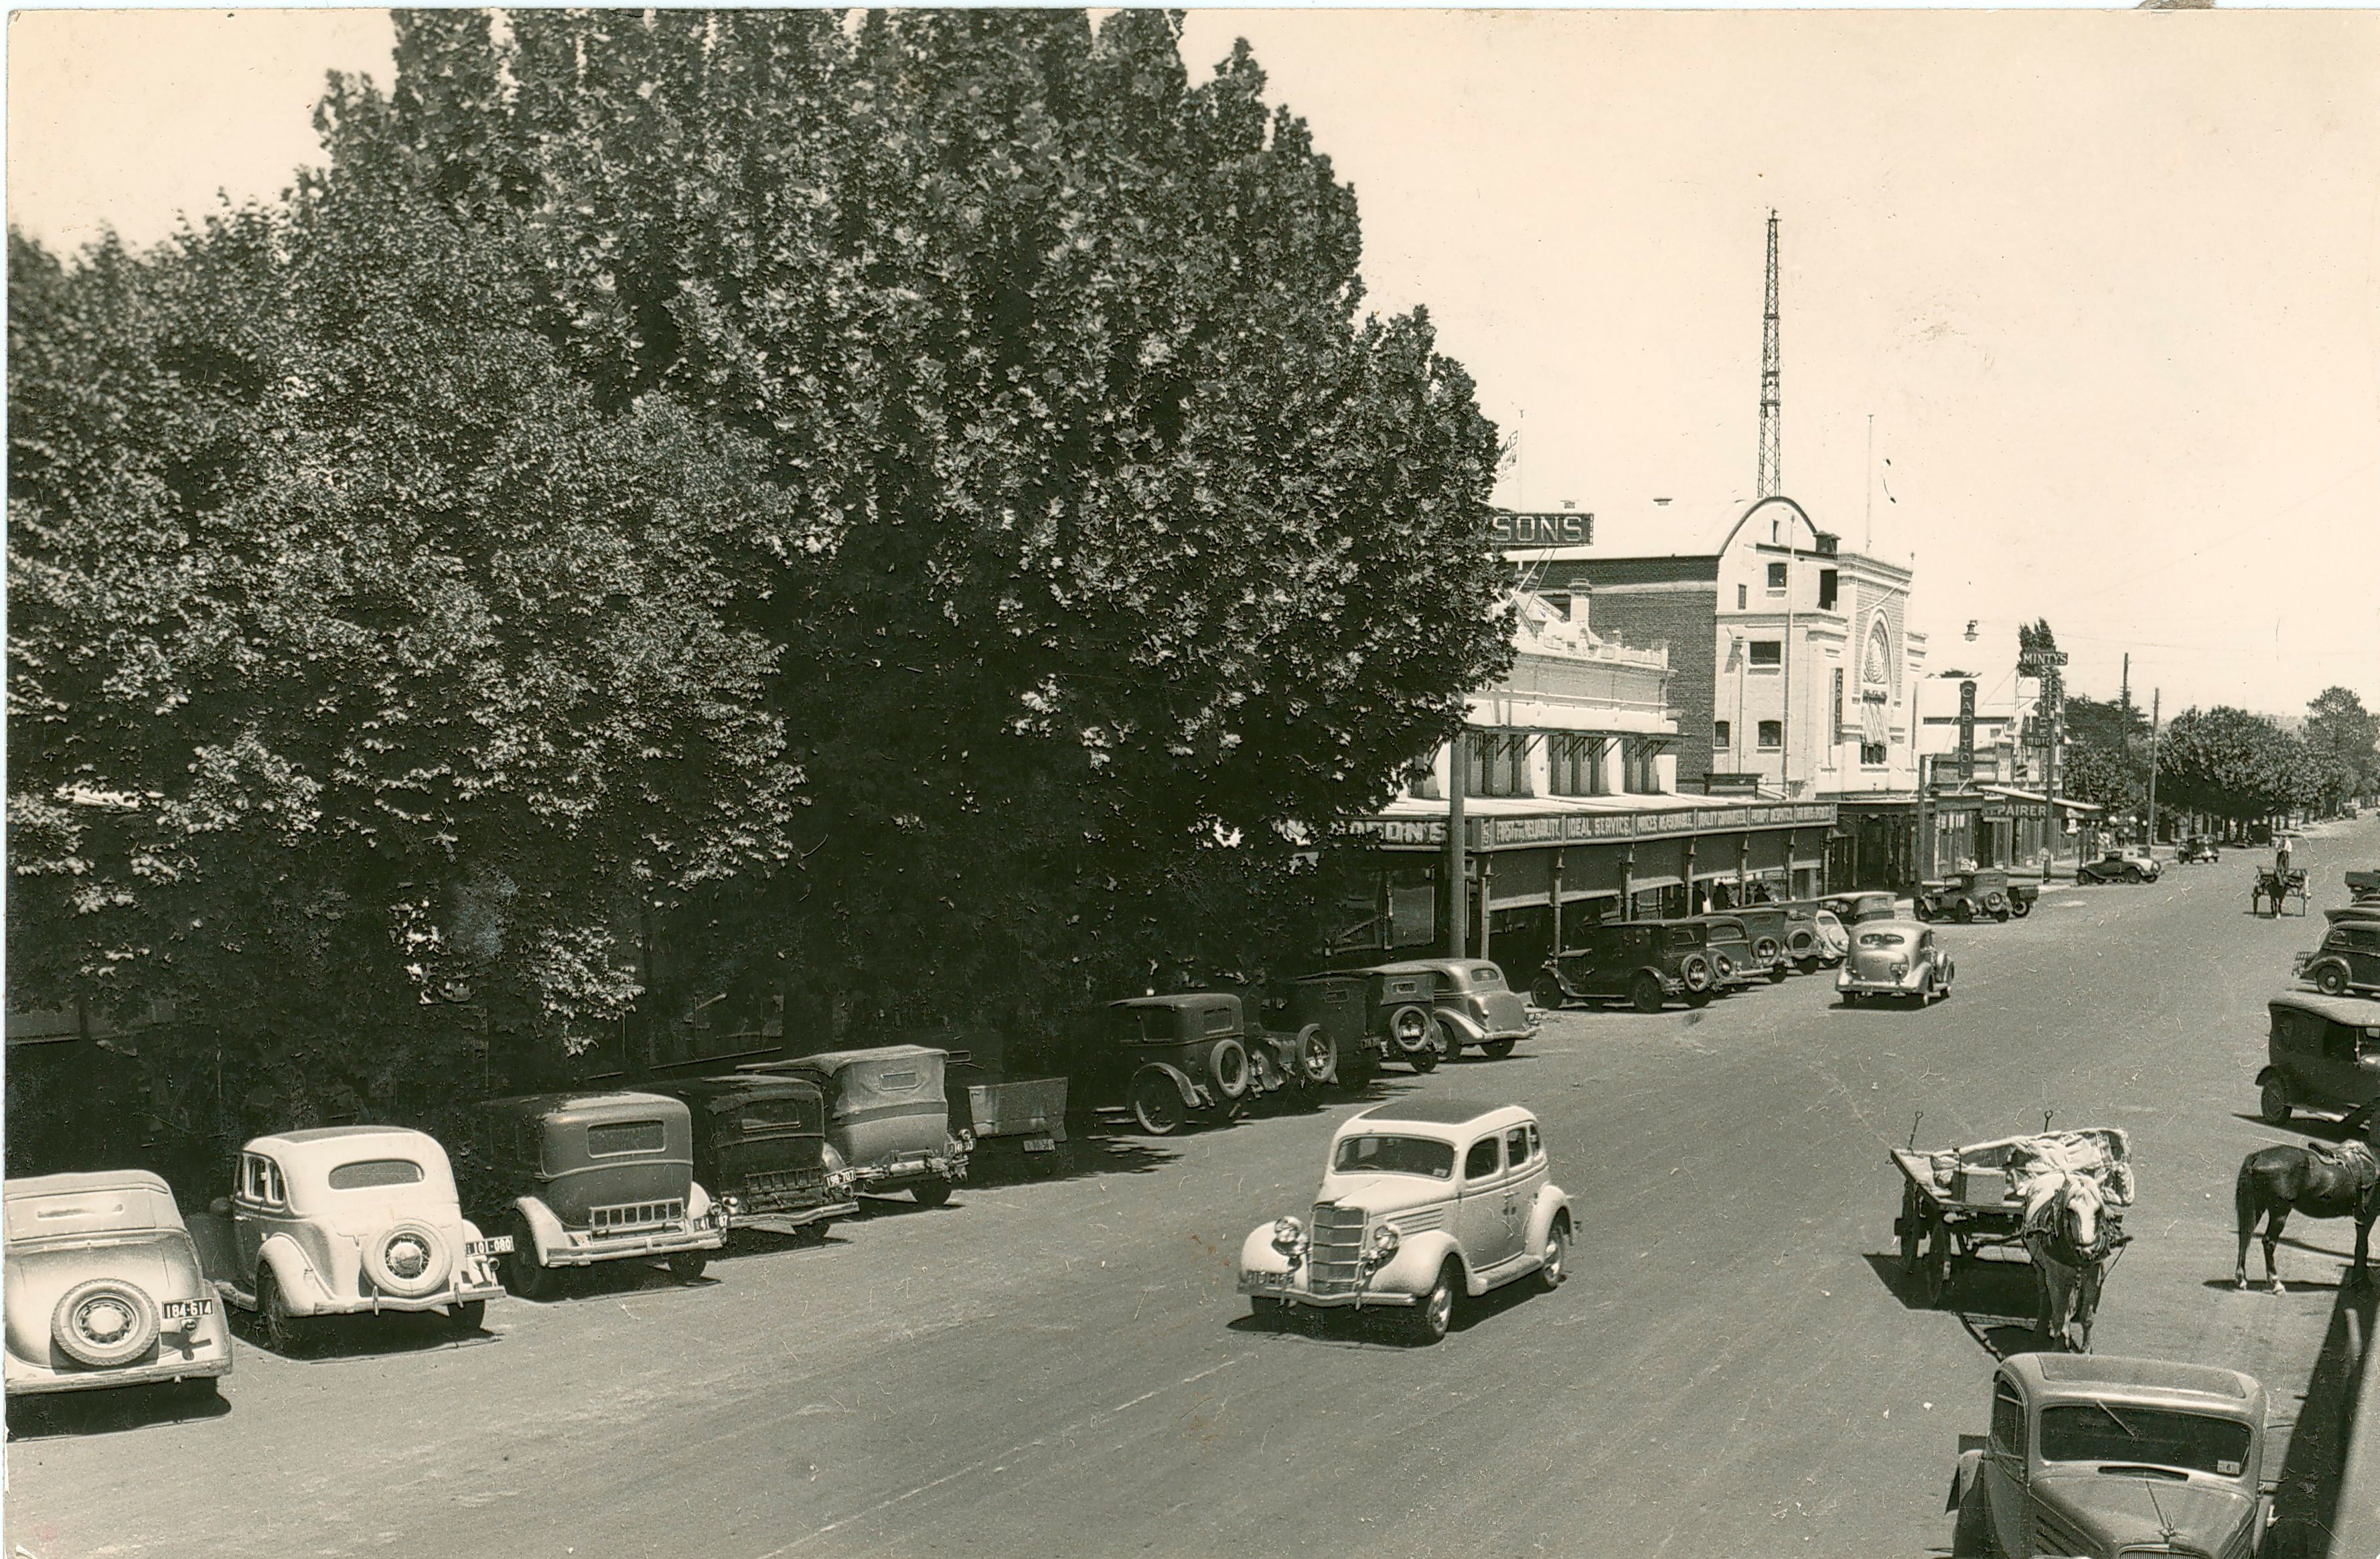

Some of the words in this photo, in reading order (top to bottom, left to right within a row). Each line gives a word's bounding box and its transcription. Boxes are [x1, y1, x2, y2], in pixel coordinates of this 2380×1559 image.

[2024, 652, 2067, 665] MINTYS
[1960, 686, 1973, 776] CAPITOL
[1567, 817, 1592, 838] IDEAL
